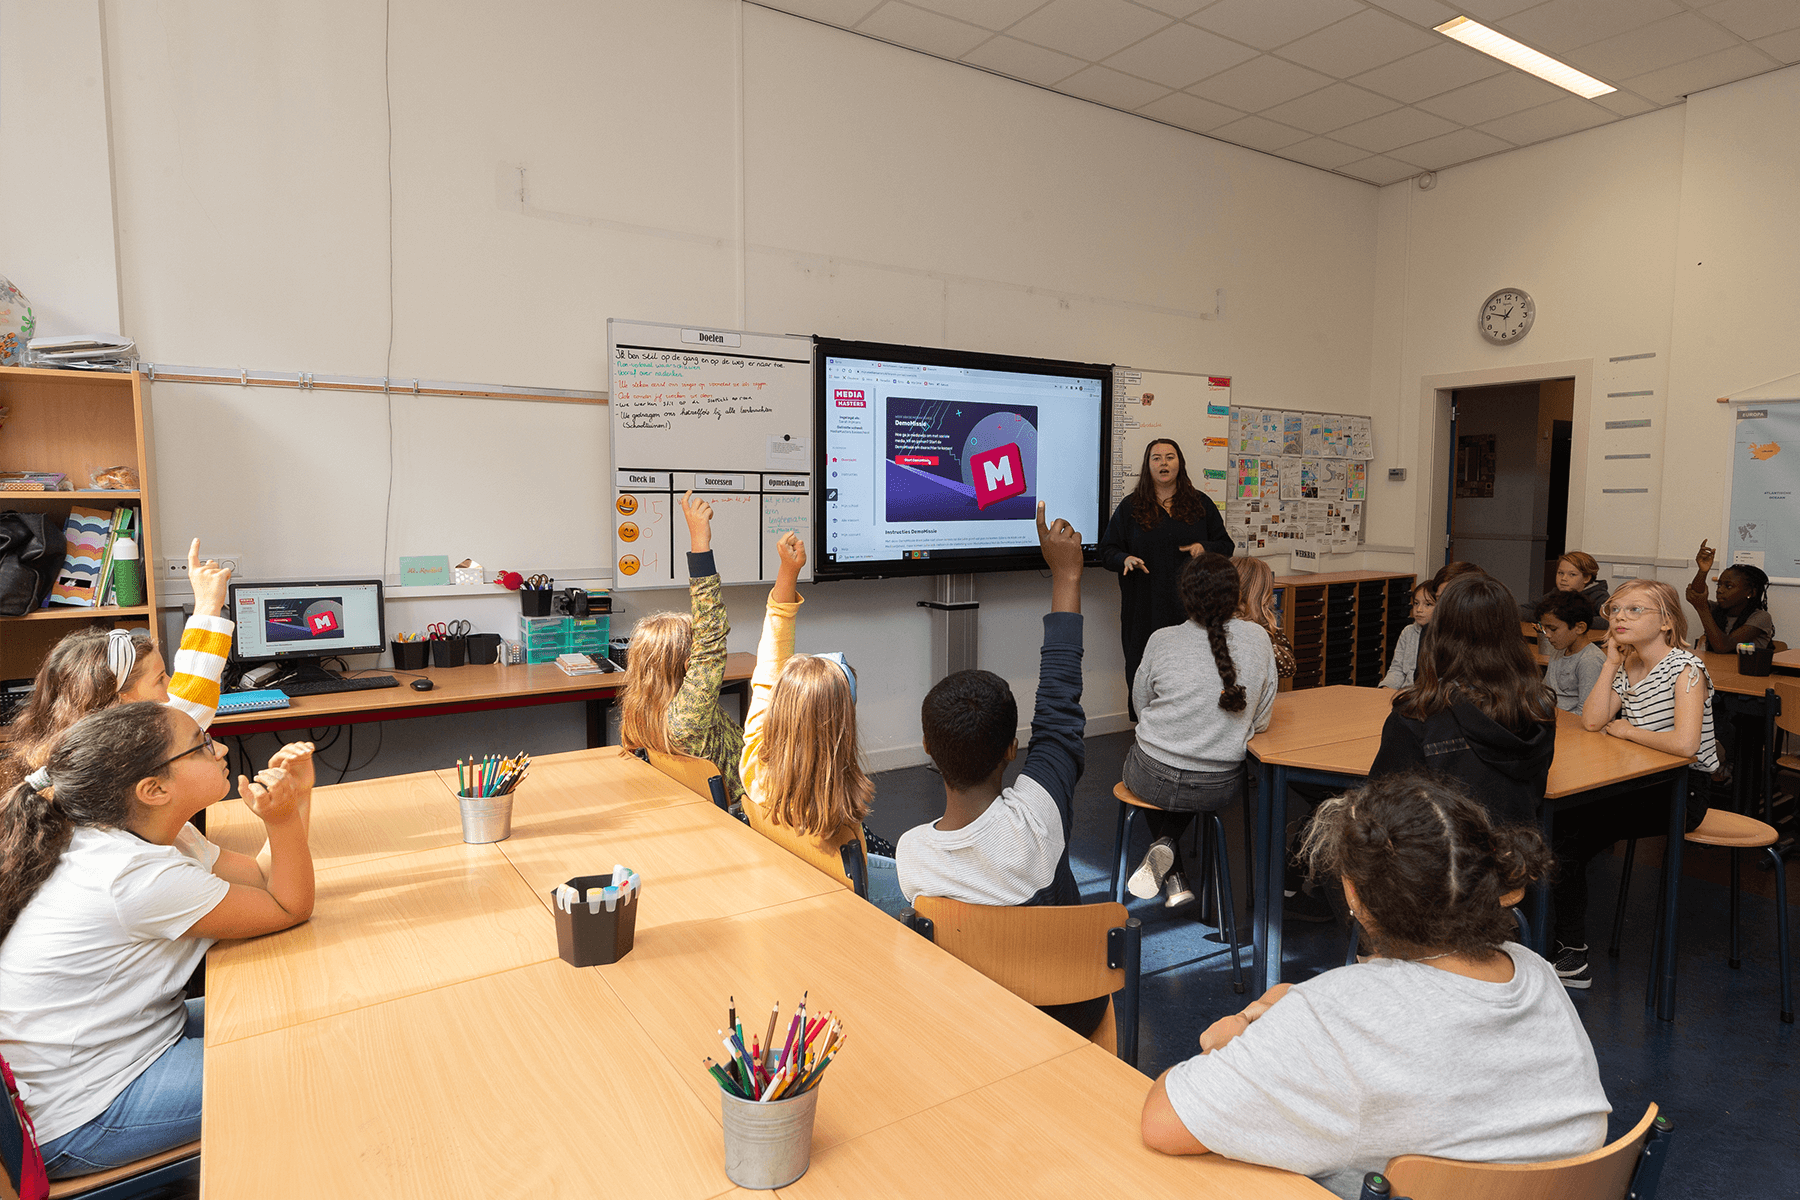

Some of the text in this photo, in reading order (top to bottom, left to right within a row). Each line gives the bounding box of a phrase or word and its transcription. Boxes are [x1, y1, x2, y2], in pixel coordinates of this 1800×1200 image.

[699, 332, 724, 344] Doelen
[628, 350, 640, 360] ben
[661, 354, 670, 363] op
[683, 356, 699, 366] gang
[732, 360, 744, 368] weg
[629, 475, 656, 484] Check in
[983, 455, 1014, 492] M
[704, 478, 733, 486] Successen
[768, 478, 805, 488] Opmerkingen
[314, 615, 332, 630] M
